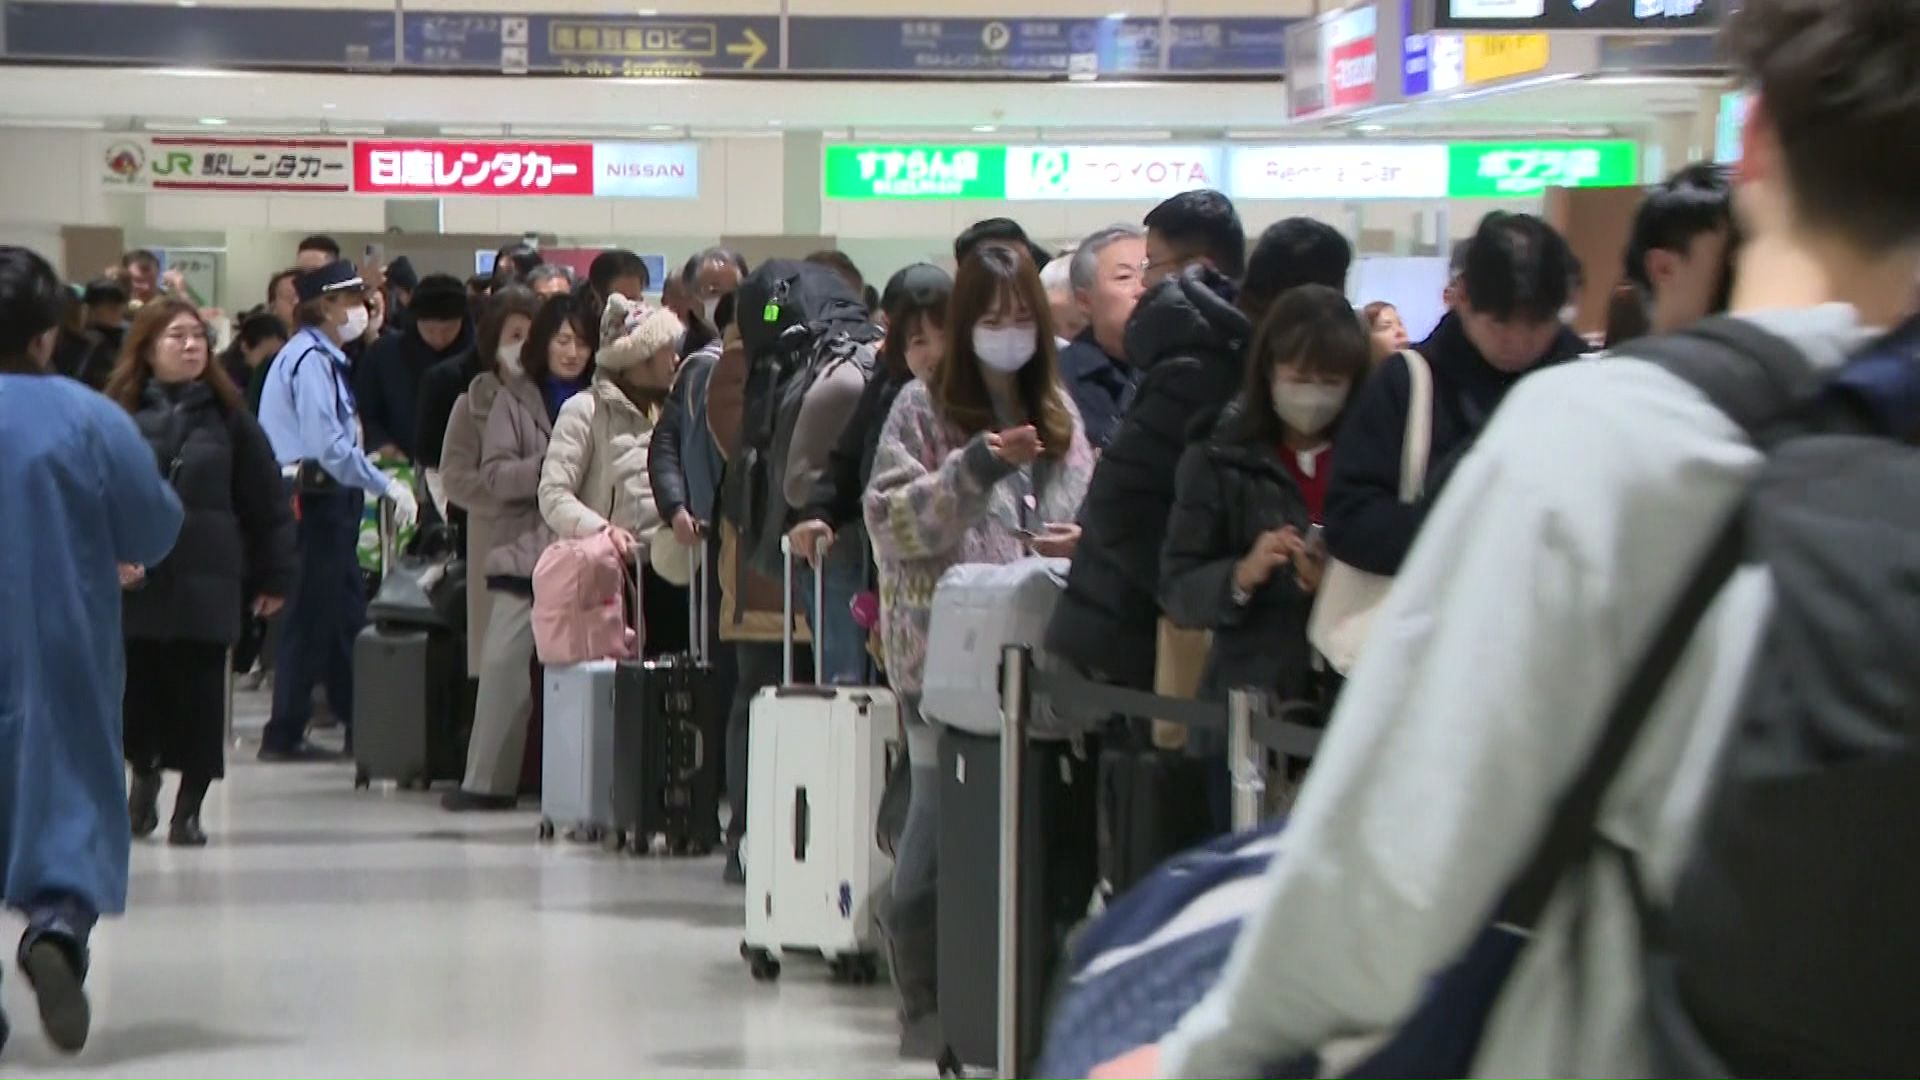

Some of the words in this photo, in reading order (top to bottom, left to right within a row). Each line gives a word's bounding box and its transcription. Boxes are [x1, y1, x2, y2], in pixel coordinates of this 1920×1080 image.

[562, 60, 580, 75] To
[586, 60, 614, 75] the
[622, 60, 703, 76] Southside
[152, 152, 193, 175] JR
[202, 153, 344, 179] 駅レンタカー
[369, 150, 577, 187] 日産レンタカー
[607, 163, 685, 177] NISSAN
